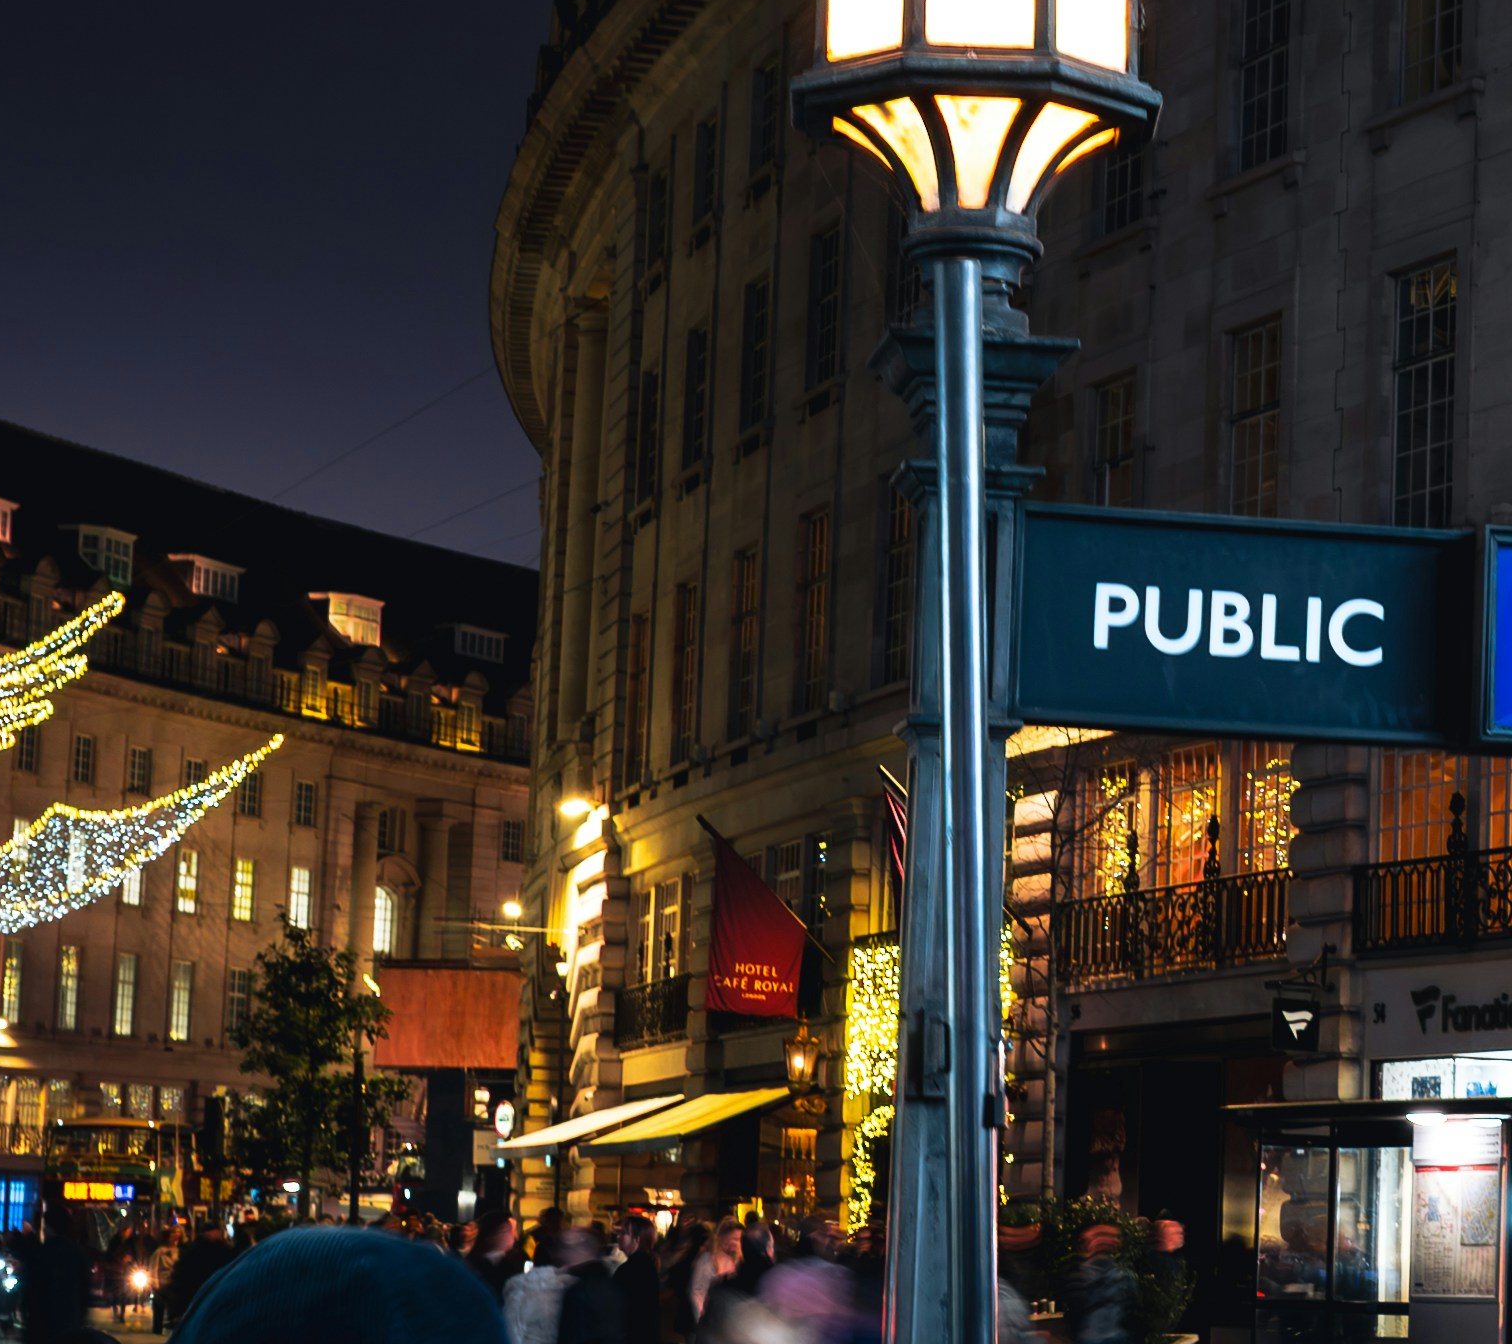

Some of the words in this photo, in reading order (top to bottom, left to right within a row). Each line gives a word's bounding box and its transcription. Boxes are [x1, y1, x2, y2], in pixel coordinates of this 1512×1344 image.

[1093, 581, 1385, 666] PUBLIC
[735, 962, 778, 978] HOTEL
[754, 979, 794, 993] ROYAL
